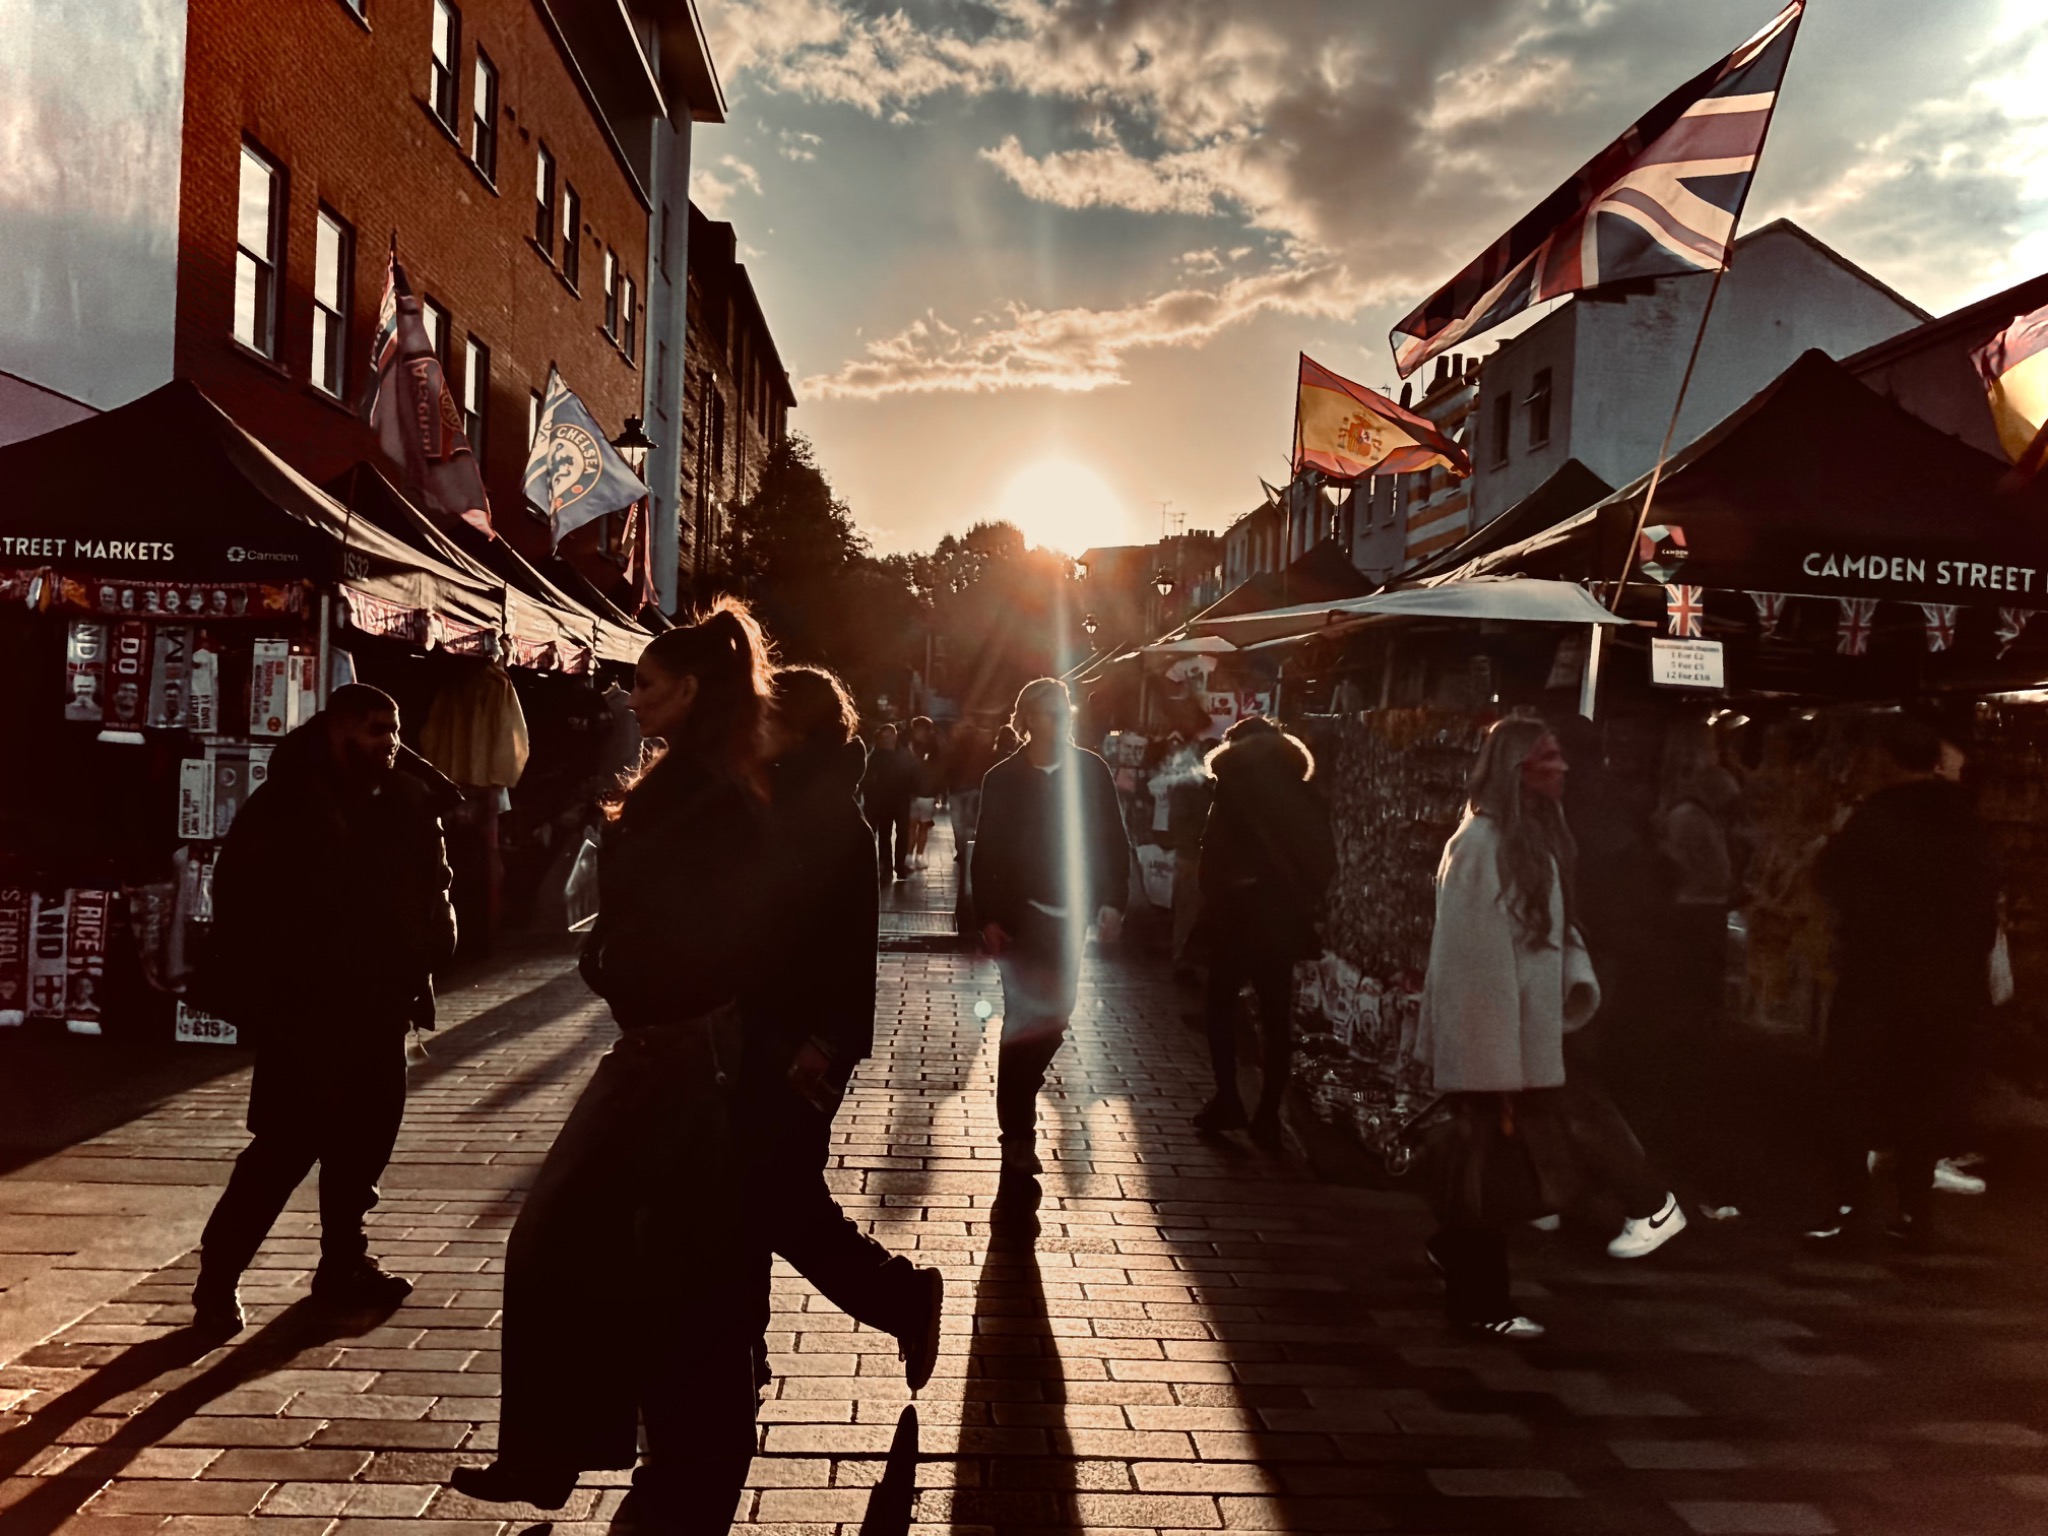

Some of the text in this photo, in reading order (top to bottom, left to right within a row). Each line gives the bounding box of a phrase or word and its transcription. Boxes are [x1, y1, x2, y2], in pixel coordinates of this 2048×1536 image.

[556, 427, 598, 475] CHELSEA
[0, 536, 175, 562] TREET MARKETS
[247, 549, 299, 562] Camden
[1802, 552, 2037, 593] CAMDEN STREET
[74, 905, 103, 952] RICE
[193, 1020, 221, 1038] £15
